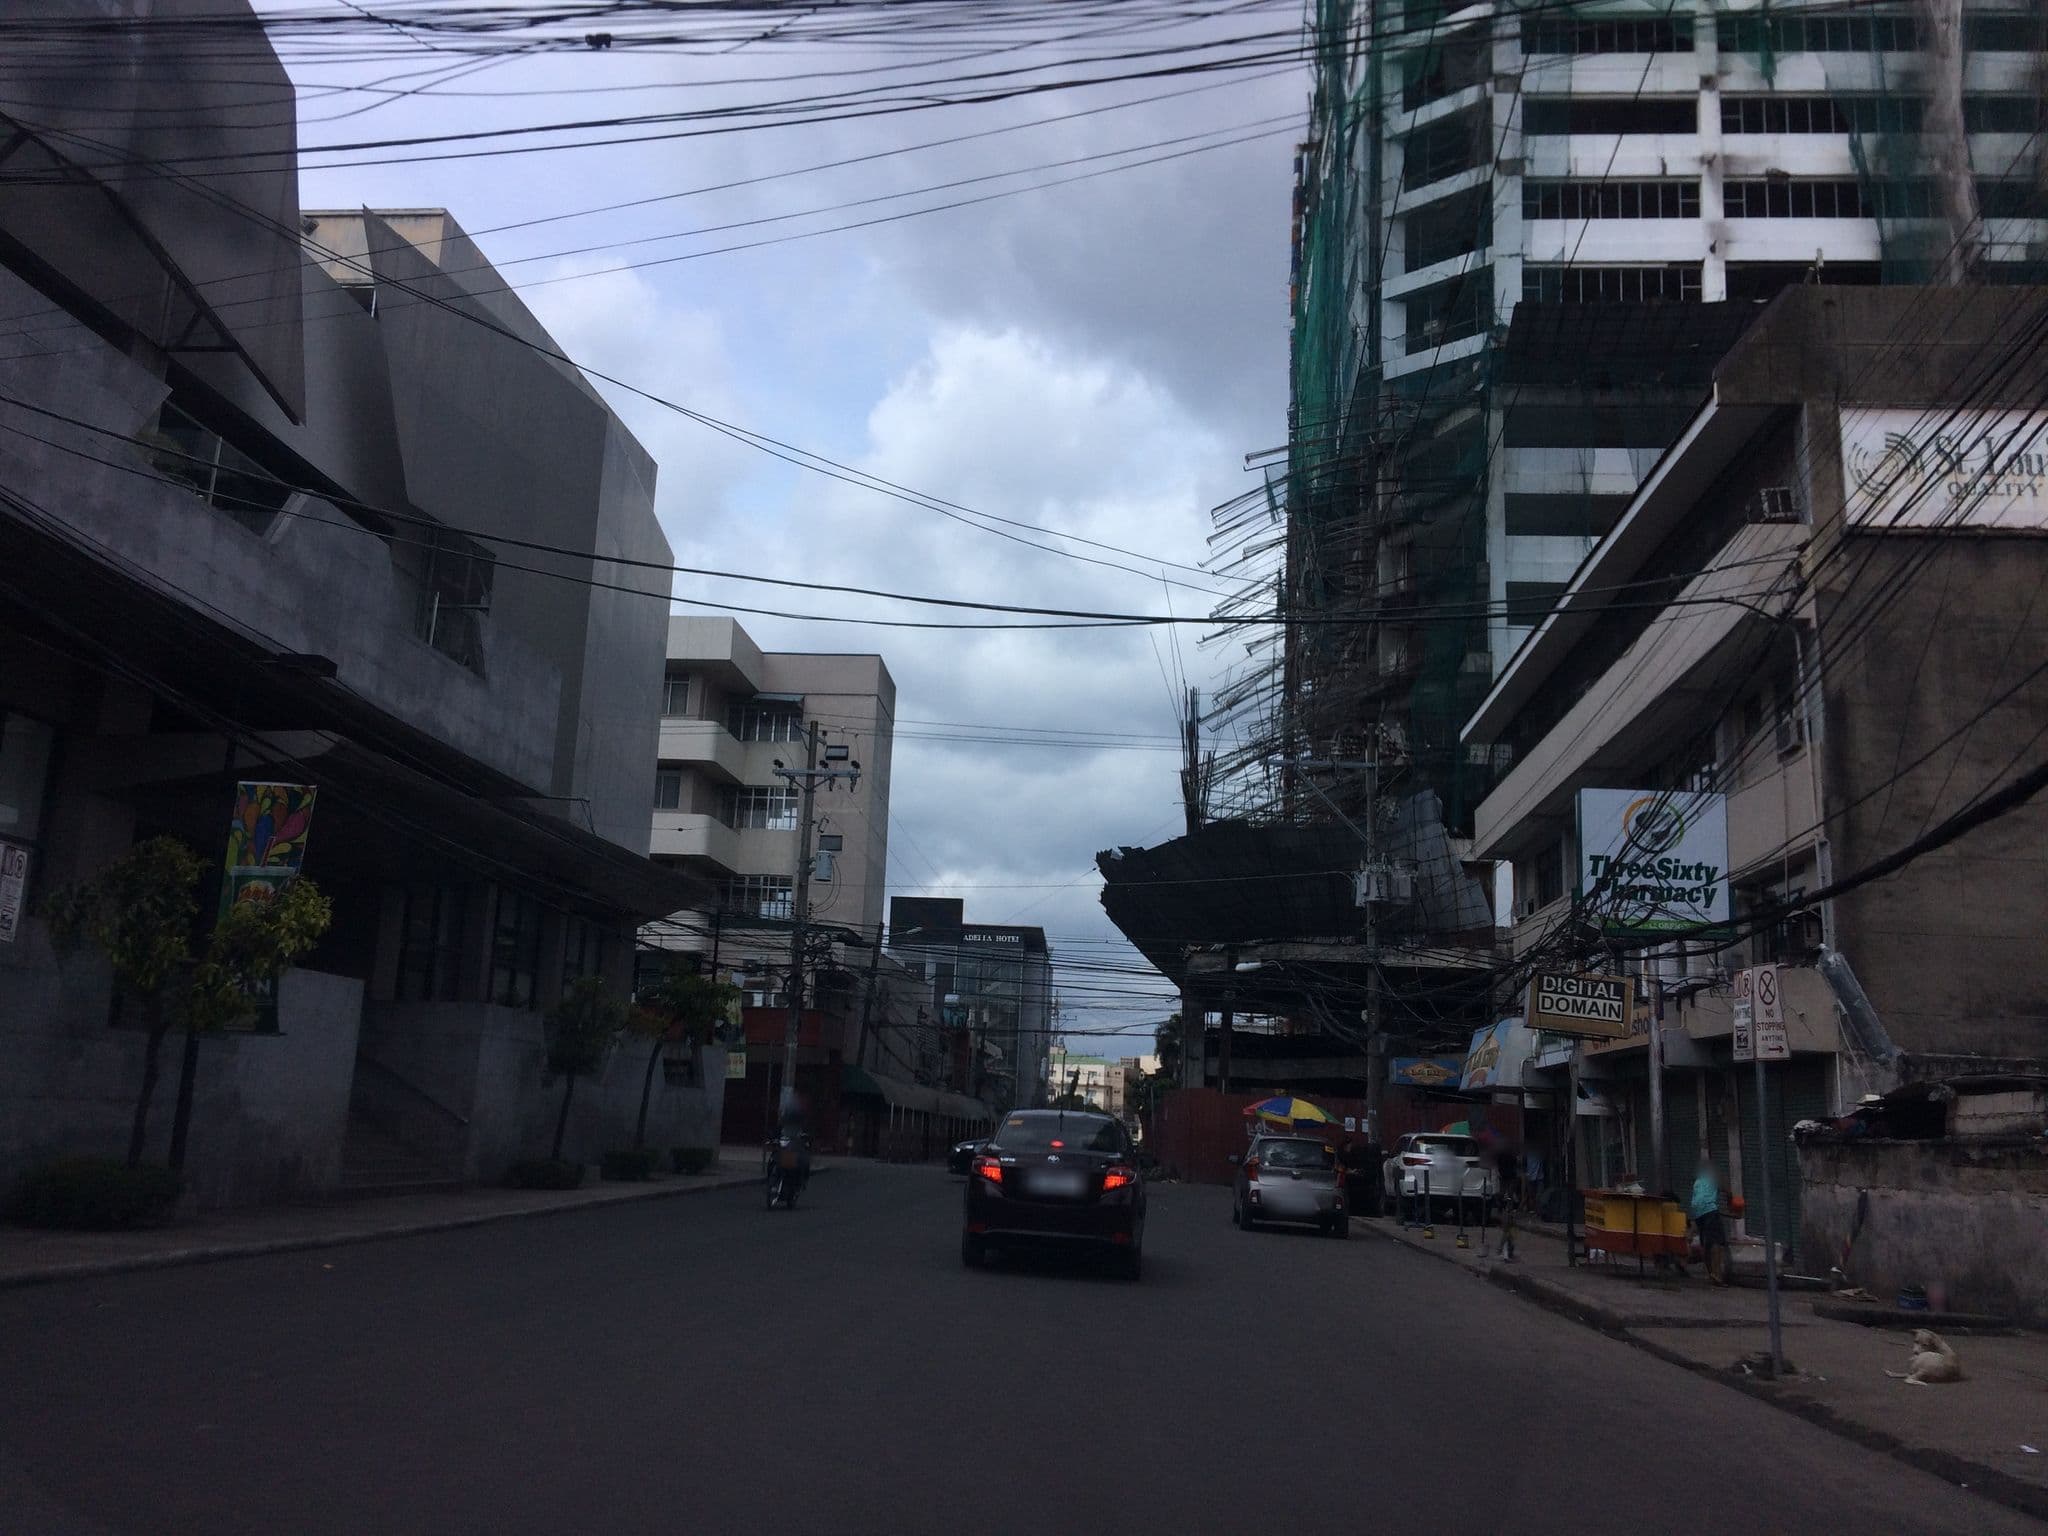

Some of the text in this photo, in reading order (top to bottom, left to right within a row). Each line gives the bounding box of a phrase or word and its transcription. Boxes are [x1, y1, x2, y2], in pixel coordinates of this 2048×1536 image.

[1983, 436, 2048, 477] Lou
[1948, 481, 2043, 498] QUALITY
[1589, 854, 1718, 886] ThreeSixty
[996, 935, 1019, 943] HOTEL
[1542, 975, 1622, 1000] DIGITAL
[1541, 995, 1622, 1019] DOMAIN
[1765, 1008, 1774, 1018] NO
[1756, 1022, 1785, 1032] STOPPING
[1761, 1034, 1784, 1042] ANYTIME
